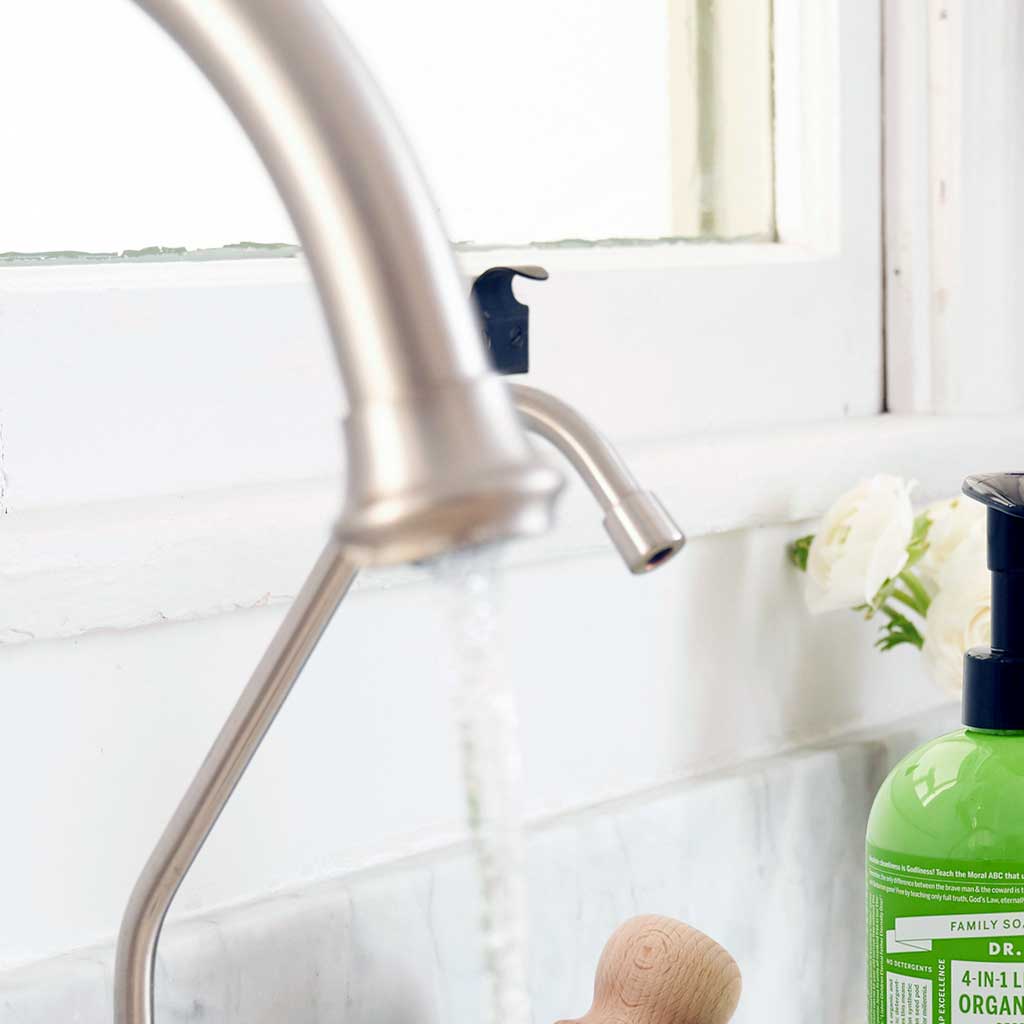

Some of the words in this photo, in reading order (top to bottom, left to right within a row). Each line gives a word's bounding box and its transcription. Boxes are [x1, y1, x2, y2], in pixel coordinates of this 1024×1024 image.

[955, 870, 966, 878] the
[967, 871, 987, 879] Moral
[951, 920, 998, 931] FAMILY
[989, 942, 1021, 956] DR.
[894, 960, 932, 973] DETERGENTS
[962, 970, 1007, 988] 4-IN-1
